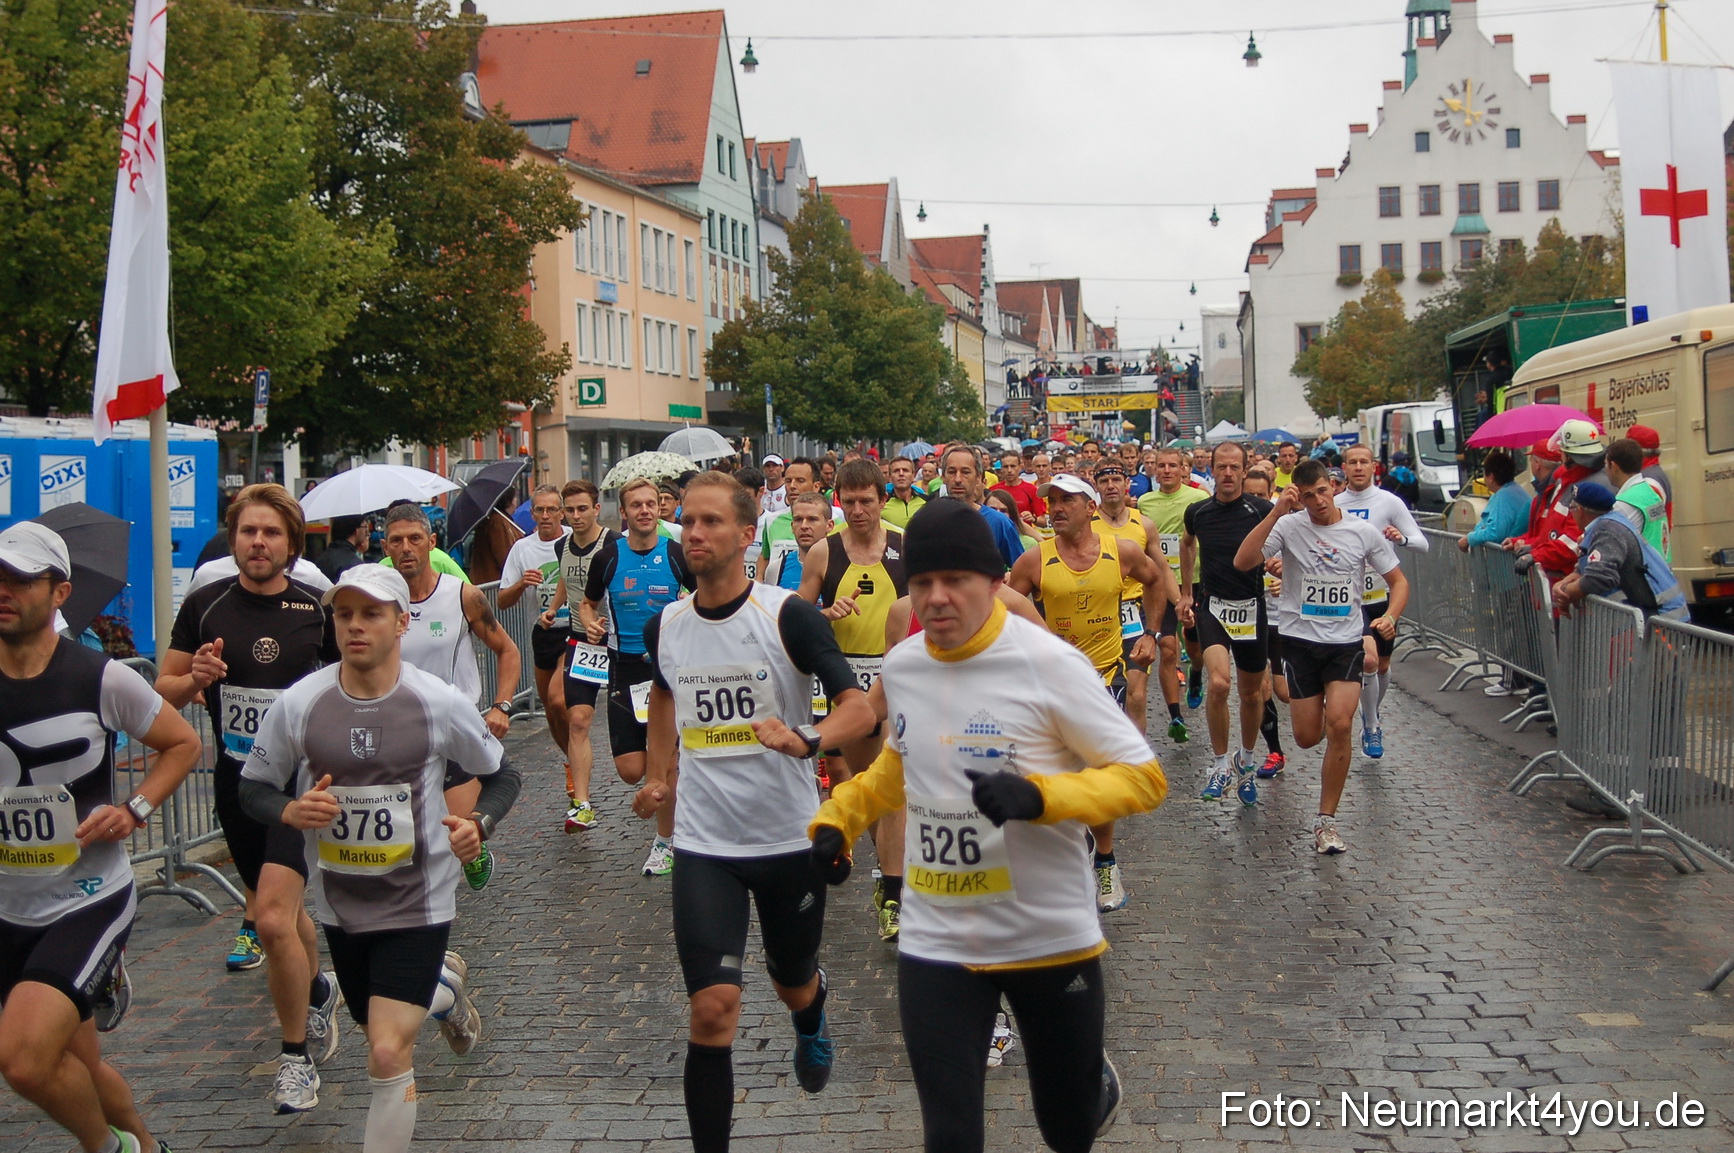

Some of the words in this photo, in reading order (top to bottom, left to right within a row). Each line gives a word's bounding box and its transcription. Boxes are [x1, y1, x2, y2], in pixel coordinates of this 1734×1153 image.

[258, 375, 267, 401] P
[582, 381, 601, 402] D
[1609, 370, 1670, 404] Bayerisches
[1083, 398, 1120, 409] START
[1609, 406, 1638, 430] Rotes
[1306, 586, 1350, 604] 2166
[291, 603, 315, 612] DEKRA
[1315, 607, 1339, 615] Fabian
[1219, 608, 1249, 623] 400
[1055, 620, 1072, 628] Seidl
[578, 652, 608, 670] 242
[678, 675, 706, 685] PARTL
[708, 673, 753, 684] Neumarkt
[222, 691, 247, 703] PARTL
[695, 686, 756, 723] 506
[705, 730, 752, 745] Hannes
[3, 794, 55, 806] Neumarkt
[345, 794, 393, 805] Neumarkt
[928, 808, 981, 820] Neumarkt
[331, 807, 394, 842] 378
[919, 822, 982, 866] 526
[0, 848, 56, 865] Matthias
[339, 848, 387, 863] Markus
[914, 868, 989, 893] LOTHAR
